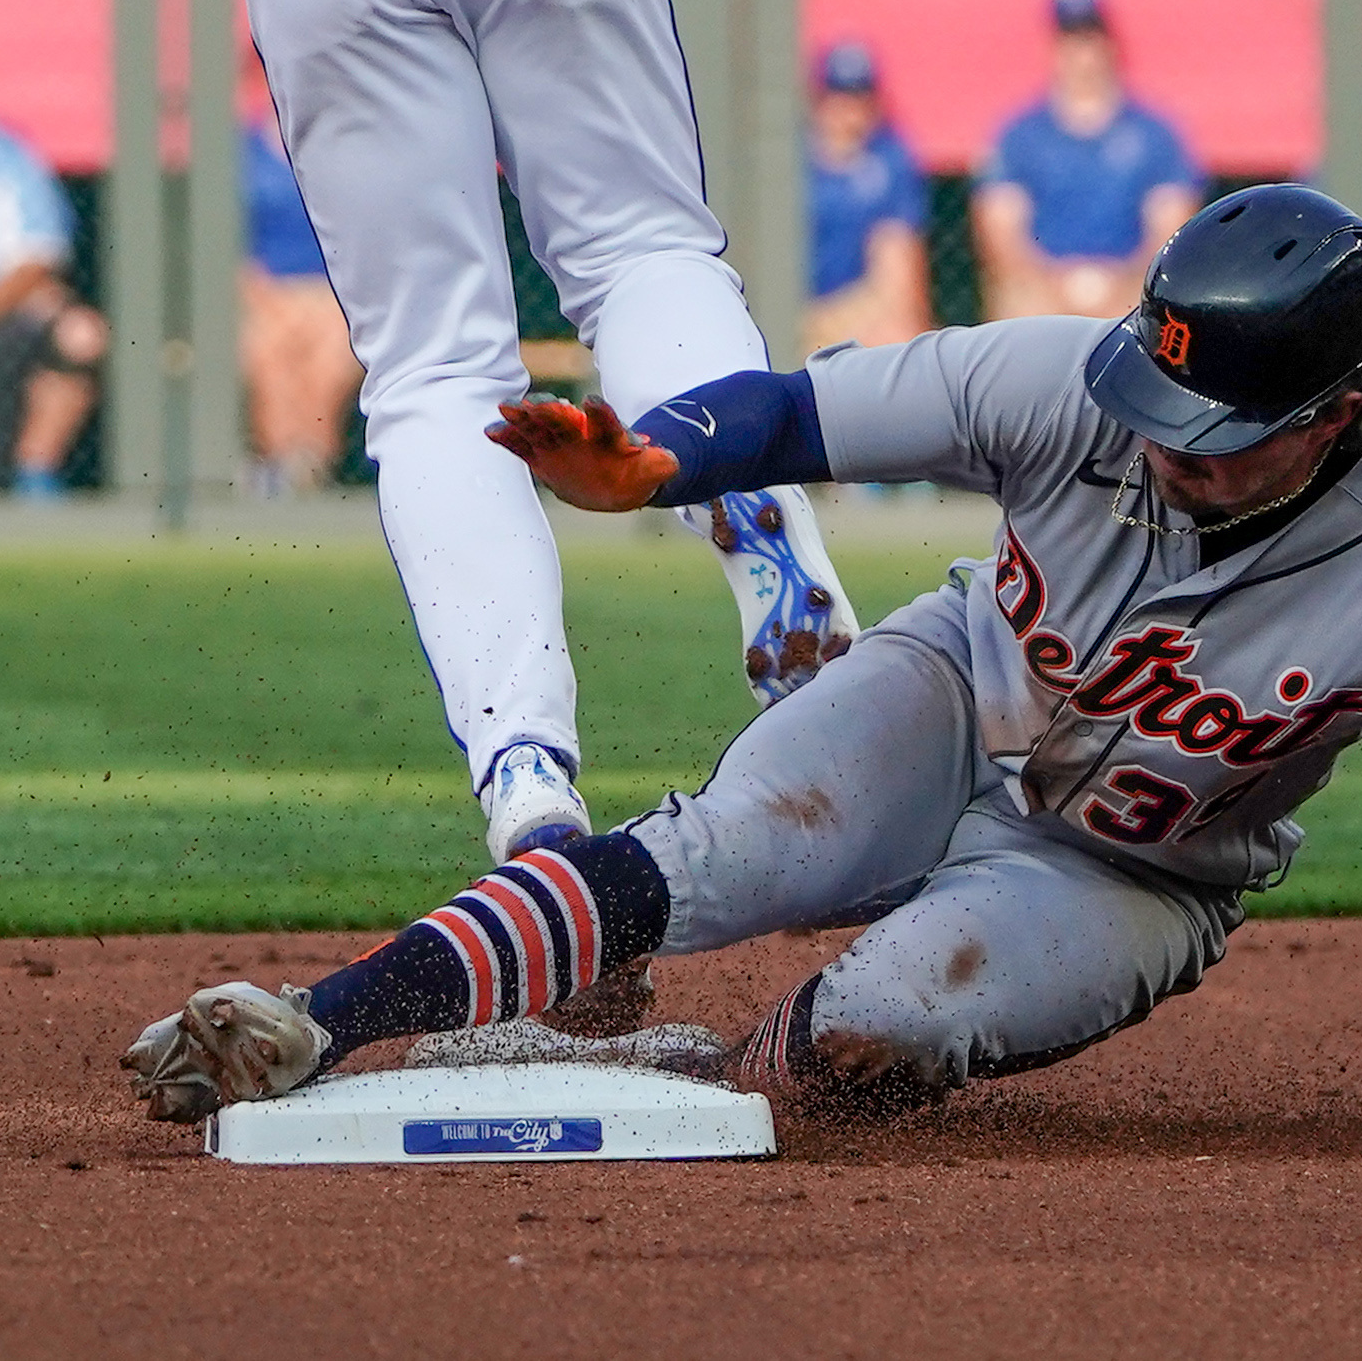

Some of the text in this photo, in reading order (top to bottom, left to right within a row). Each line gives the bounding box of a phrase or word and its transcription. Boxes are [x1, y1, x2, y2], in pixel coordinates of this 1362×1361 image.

[1153, 305, 1192, 371] D
[441, 1123, 479, 1140] WELCOME
[480, 1123, 491, 1140] TO
[508, 1119, 550, 1152] City
